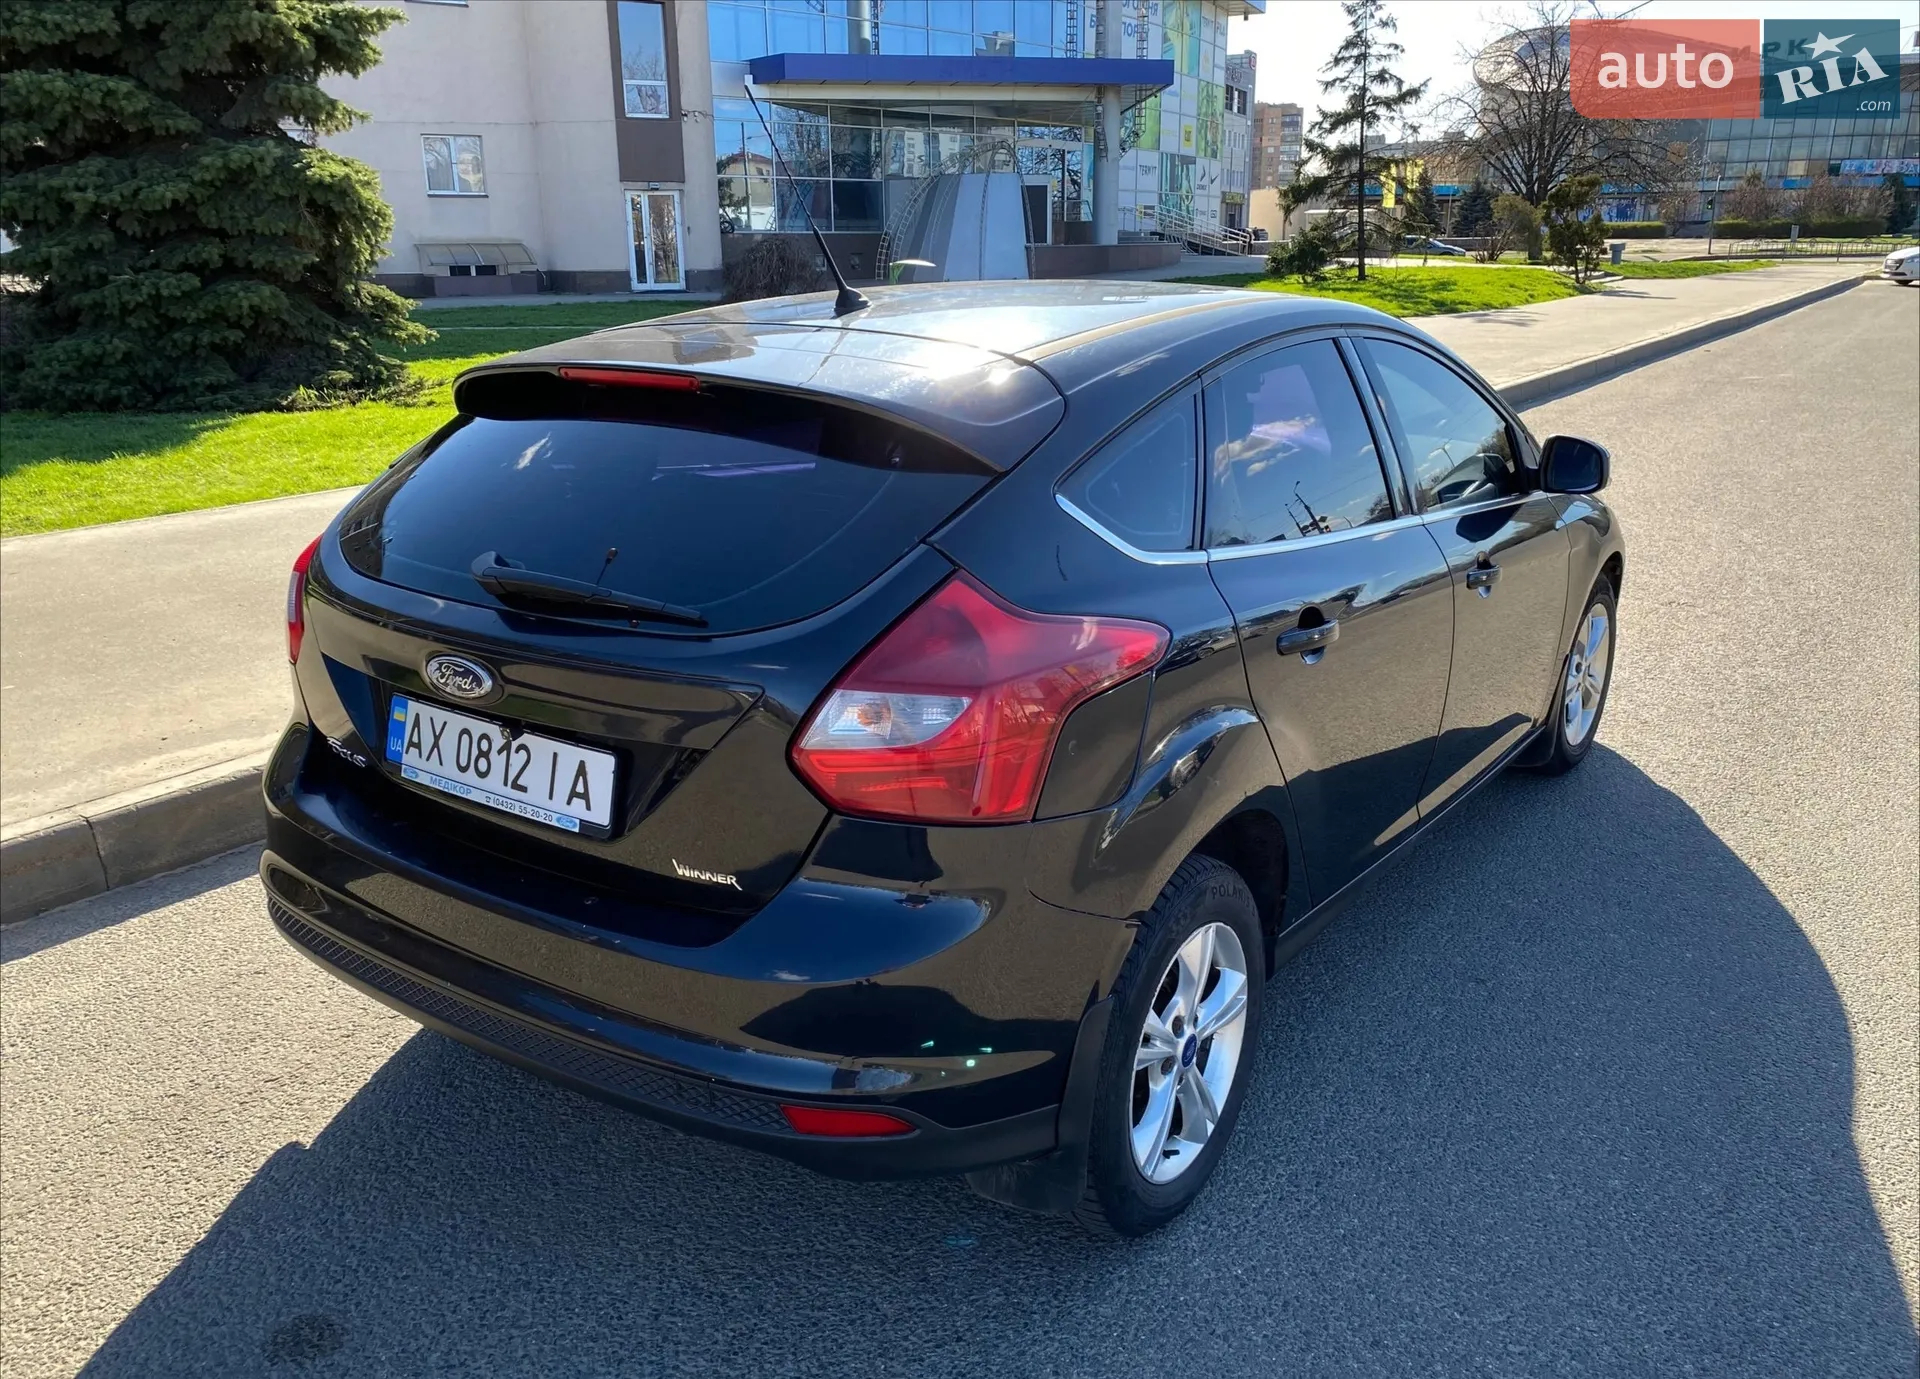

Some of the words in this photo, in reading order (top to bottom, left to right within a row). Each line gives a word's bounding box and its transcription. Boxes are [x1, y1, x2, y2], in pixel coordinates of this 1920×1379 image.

[438, 663, 474, 690] Ford
[390, 736, 402, 753] UA
[405, 712, 447, 767] AX
[456, 727, 532, 793] 0812
[548, 751, 591, 811] IA
[429, 776, 472, 797] МЕДІКОР
[493, 796, 516, 812] (0432)
[518, 805, 553, 822] 55-20-20
[672, 858, 743, 891] WINNER
